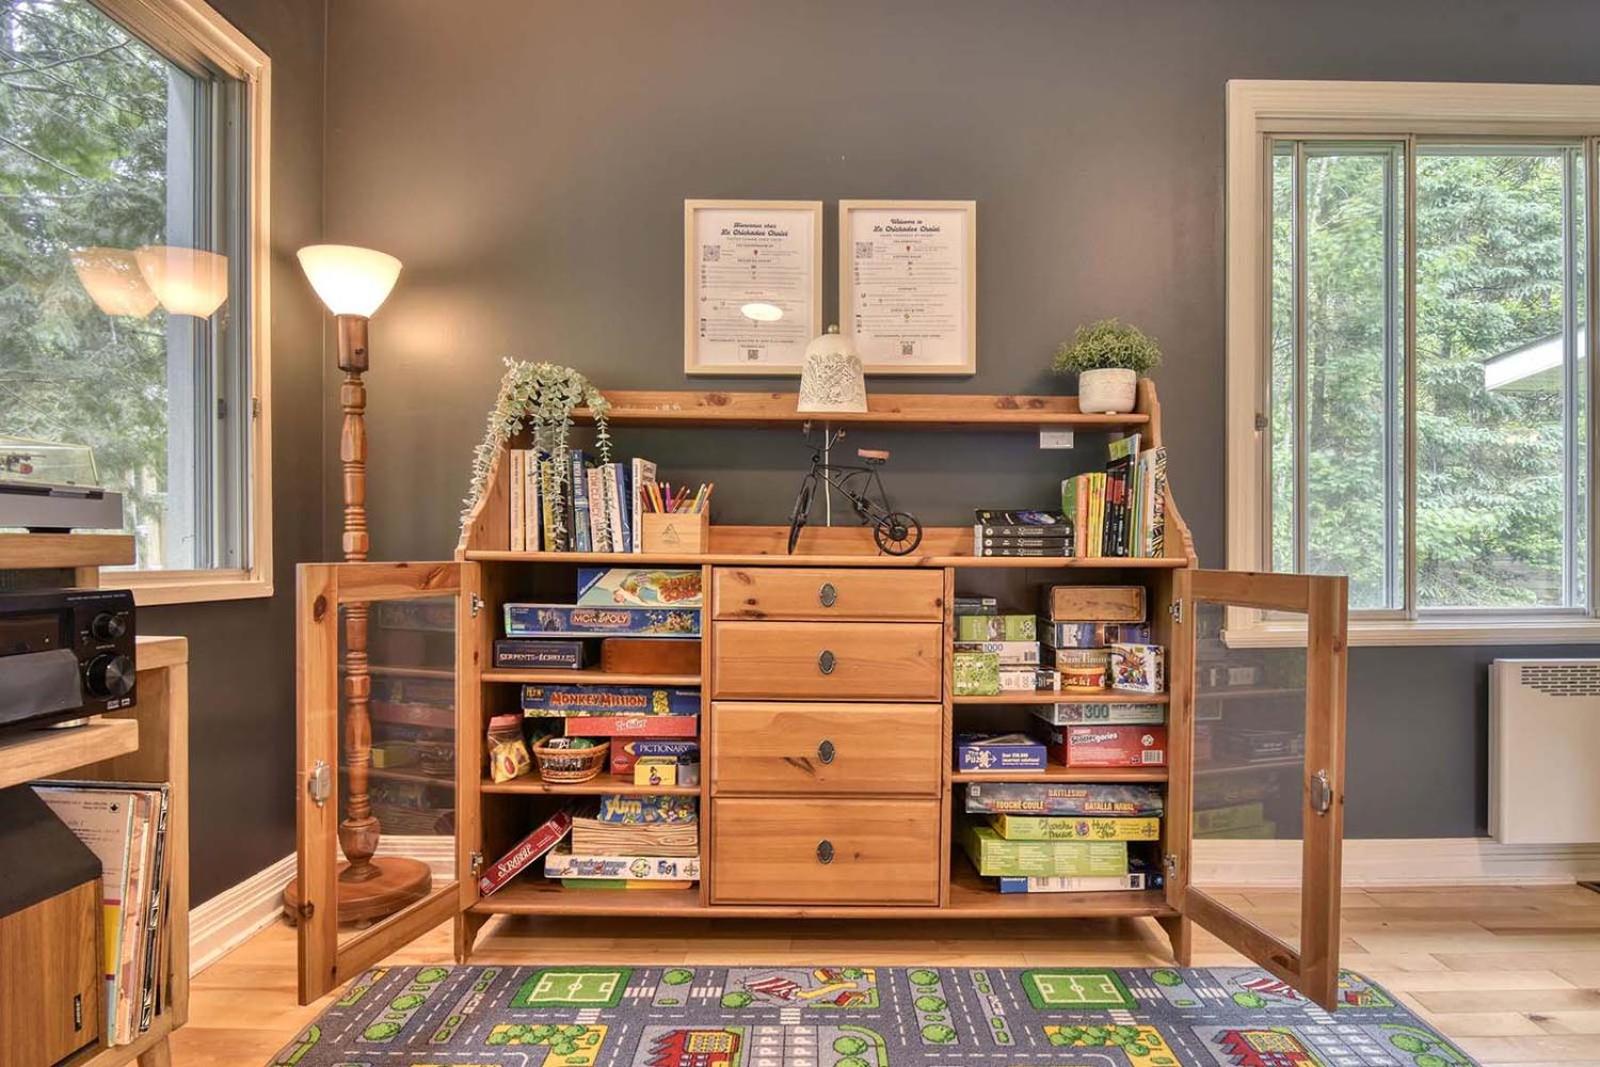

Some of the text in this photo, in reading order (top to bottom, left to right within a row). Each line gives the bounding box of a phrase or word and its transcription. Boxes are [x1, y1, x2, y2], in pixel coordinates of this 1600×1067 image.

[551, 691, 599, 706] MONKEY
[601, 692, 647, 708] MISSION
[1084, 704, 1110, 719] 300
[640, 743, 689, 754] PICTIONARY
[1048, 789, 1088, 798] BATTLESHIP
